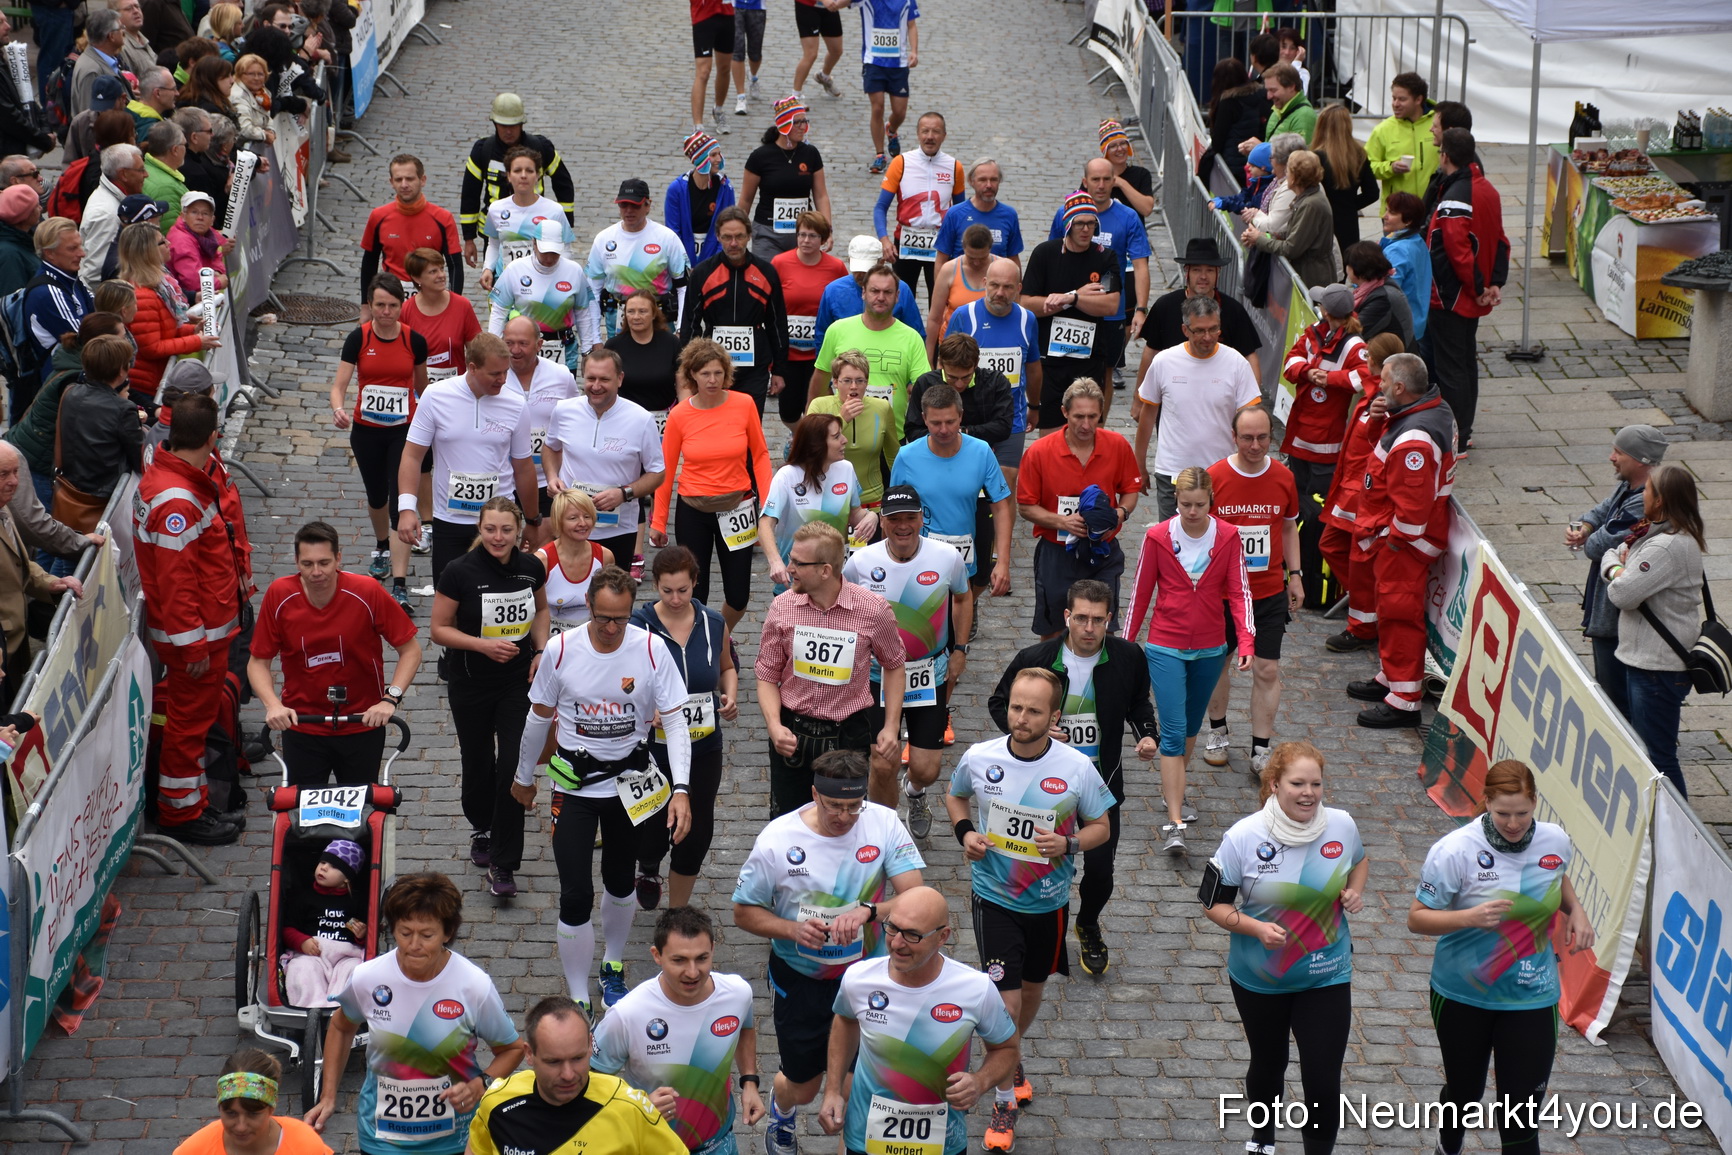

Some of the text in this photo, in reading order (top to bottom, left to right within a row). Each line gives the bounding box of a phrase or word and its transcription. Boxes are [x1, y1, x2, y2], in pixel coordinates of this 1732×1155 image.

[873, 35, 898, 47] 3038
[224, 159, 246, 230] BMW Laufsport
[904, 234, 934, 249] 2237
[202, 281, 214, 337] BMW Laufspor
[1054, 327, 1091, 346] 2458
[715, 336, 751, 351] 2563
[987, 357, 1014, 373] 380
[366, 395, 403, 413] 2041
[453, 482, 494, 501] 2331
[1217, 504, 1273, 516] NEUMARKT
[729, 511, 756, 533] 304
[494, 602, 528, 624] 385
[500, 627, 520, 636] Karin
[796, 630, 847, 643] PARTL Neumarkt
[805, 640, 844, 664] 367
[809, 665, 834, 677] Martin
[574, 698, 636, 716] twinn
[629, 774, 664, 801] 541
[1043, 781, 1066, 791] Hervis
[307, 789, 360, 808] 2042
[317, 809, 346, 820] Steffen
[991, 802, 1045, 820] PARTL Neumarkt
[1006, 816, 1035, 840] 30
[1005, 840, 1028, 854] Maze
[1323, 845, 1342, 855] Hervis
[799, 908, 820, 919] PARTL
[317, 930, 347, 941] lauf...
[1309, 956, 1343, 968] Neumarkter
[1310, 952, 1326, 962] 16.
[1308, 963, 1338, 975] Stadtlauf
[1520, 960, 1535, 971] 16.
[373, 1008, 392, 1018] PARTL
[436, 1003, 462, 1016] Hervis
[865, 1011, 889, 1021] PARTL
[934, 1006, 960, 1018] Hervis
[714, 1020, 738, 1034] Hervis
[865, 1017, 888, 1025] Neumarkt
[646, 1043, 671, 1052] PARTL
[646, 1048, 672, 1056] Neumarkt
[379, 1081, 440, 1094] PARTL Neumarkt
[383, 1093, 447, 1119] 2628
[502, 1099, 528, 1112] STANNO
[872, 1101, 935, 1117] PARTL Neumarkt
[387, 1121, 443, 1134] Rosemarie
[882, 1116, 932, 1141] 200
[573, 1140, 589, 1148] TSV
[885, 1144, 924, 1155] Norbert
